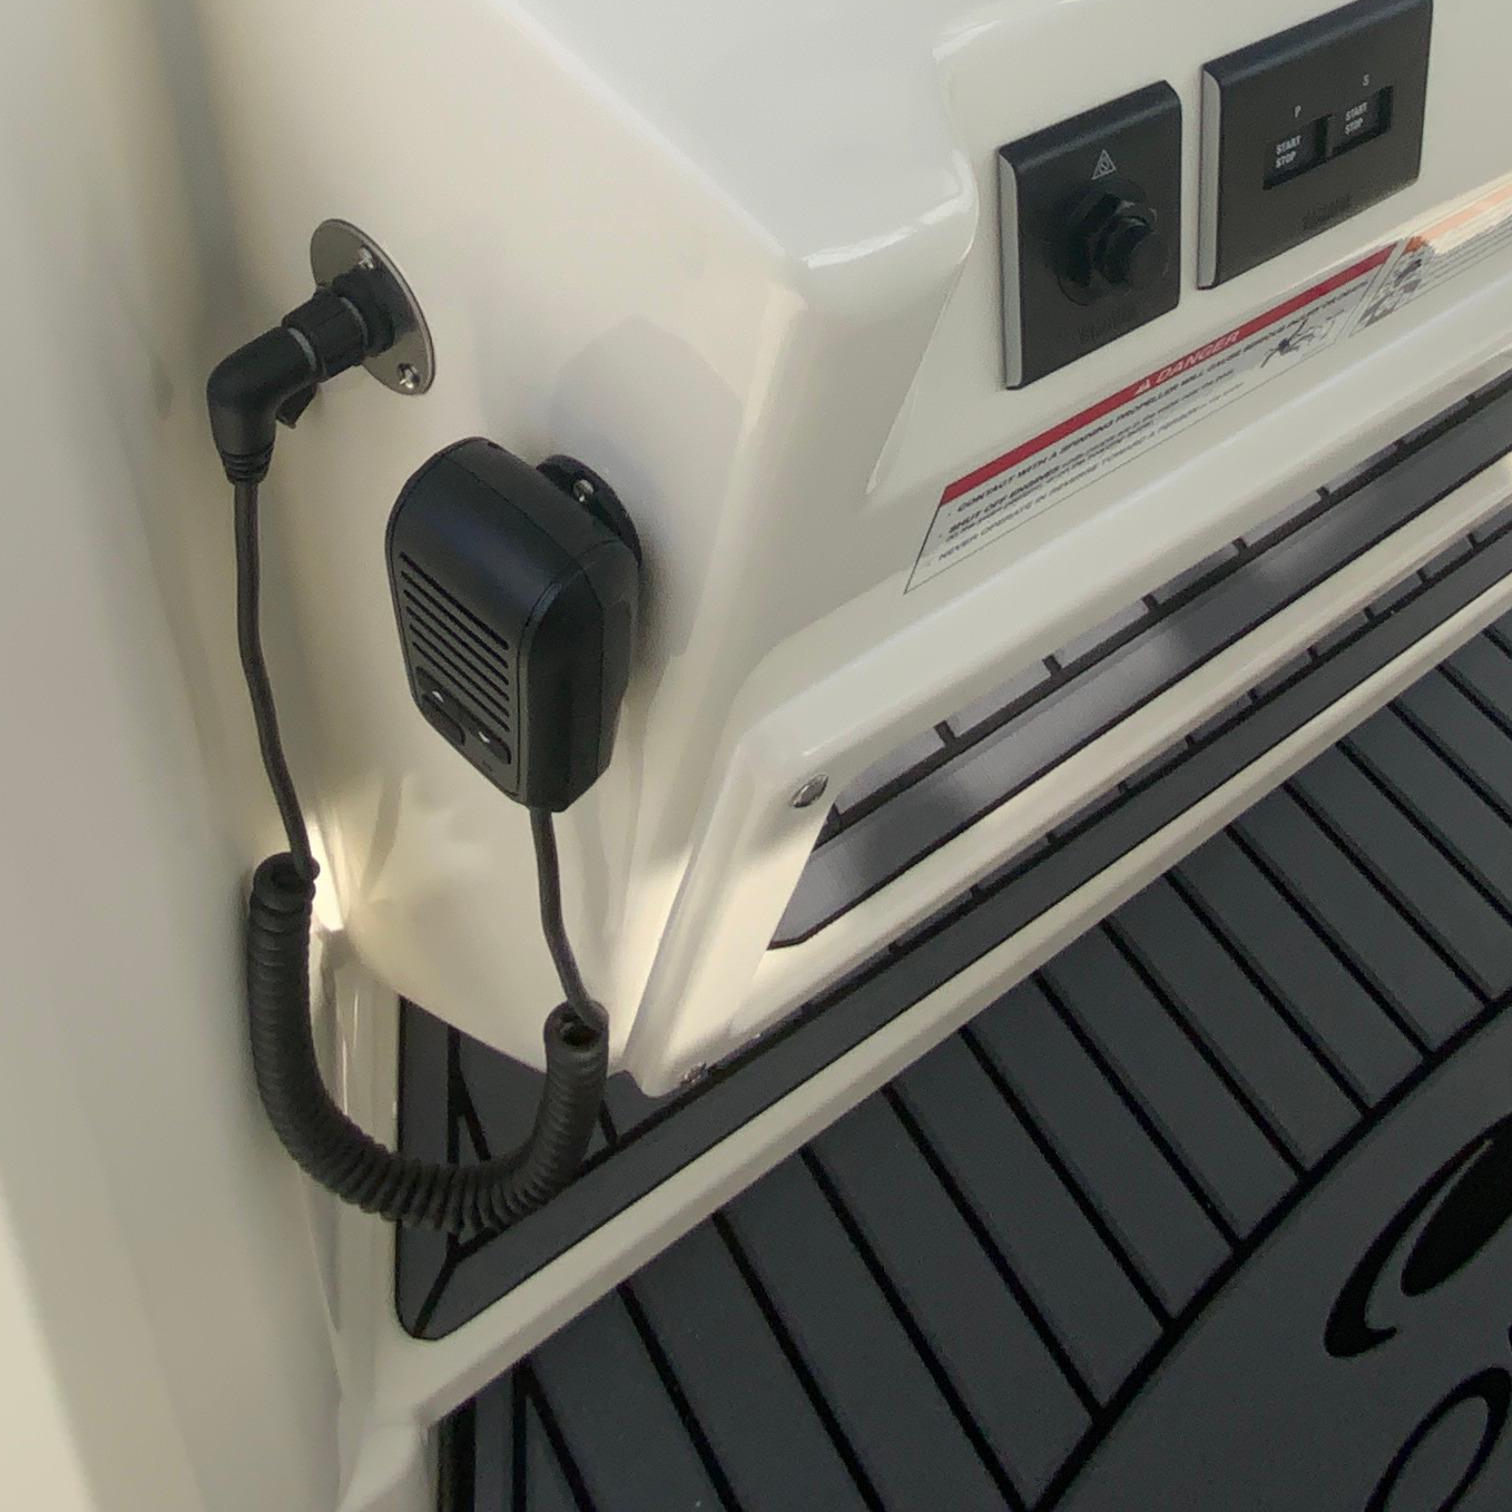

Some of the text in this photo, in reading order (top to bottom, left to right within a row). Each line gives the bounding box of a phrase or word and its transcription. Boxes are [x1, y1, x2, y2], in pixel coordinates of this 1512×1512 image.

[1362, 74, 1369, 86] S
[1294, 105, 1302, 118] P
[1345, 101, 1368, 121] START
[1276, 135, 1301, 155] START
[1275, 151, 1297, 168] STOP
[1156, 329, 1241, 383] DANGER
